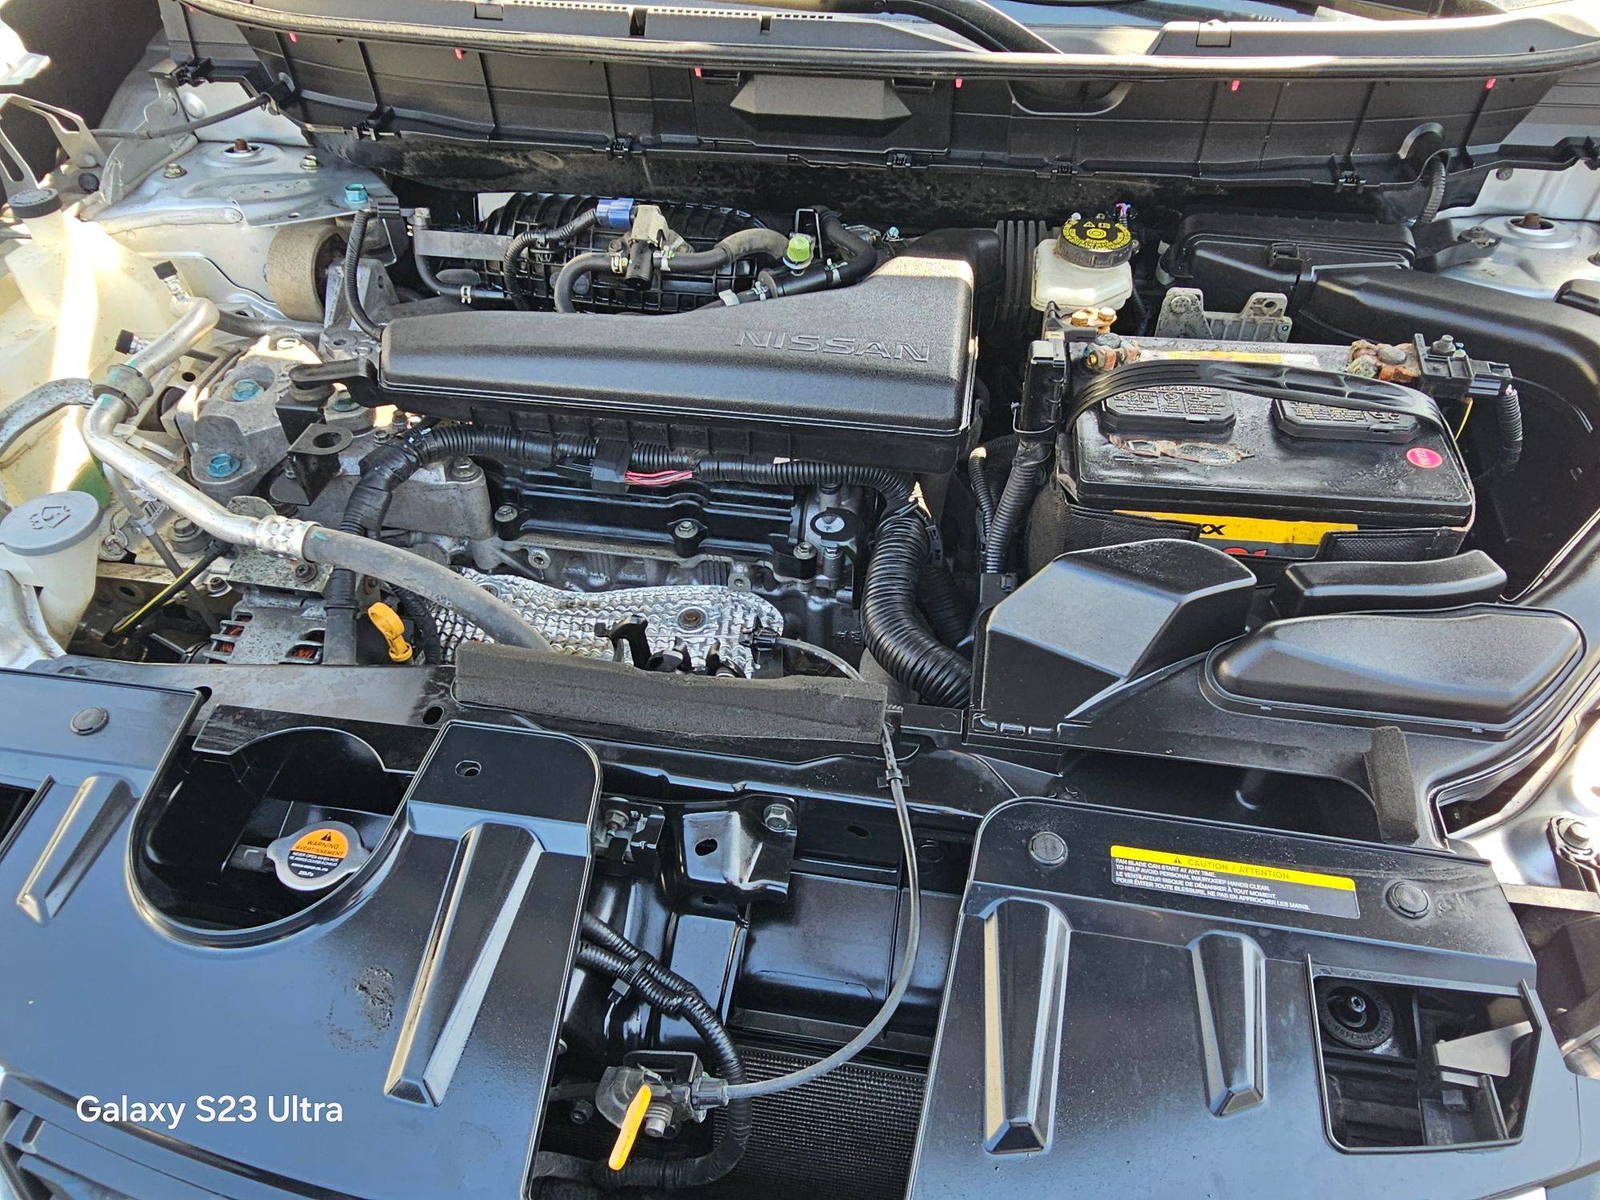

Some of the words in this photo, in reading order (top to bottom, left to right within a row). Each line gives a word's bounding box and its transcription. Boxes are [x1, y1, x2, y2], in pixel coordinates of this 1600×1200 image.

[735, 331, 930, 362] NISSAN
[307, 841, 340, 850] WARNING
[1187, 858, 1228, 870] CAUTION
[1238, 865, 1289, 879] ATTENTION
